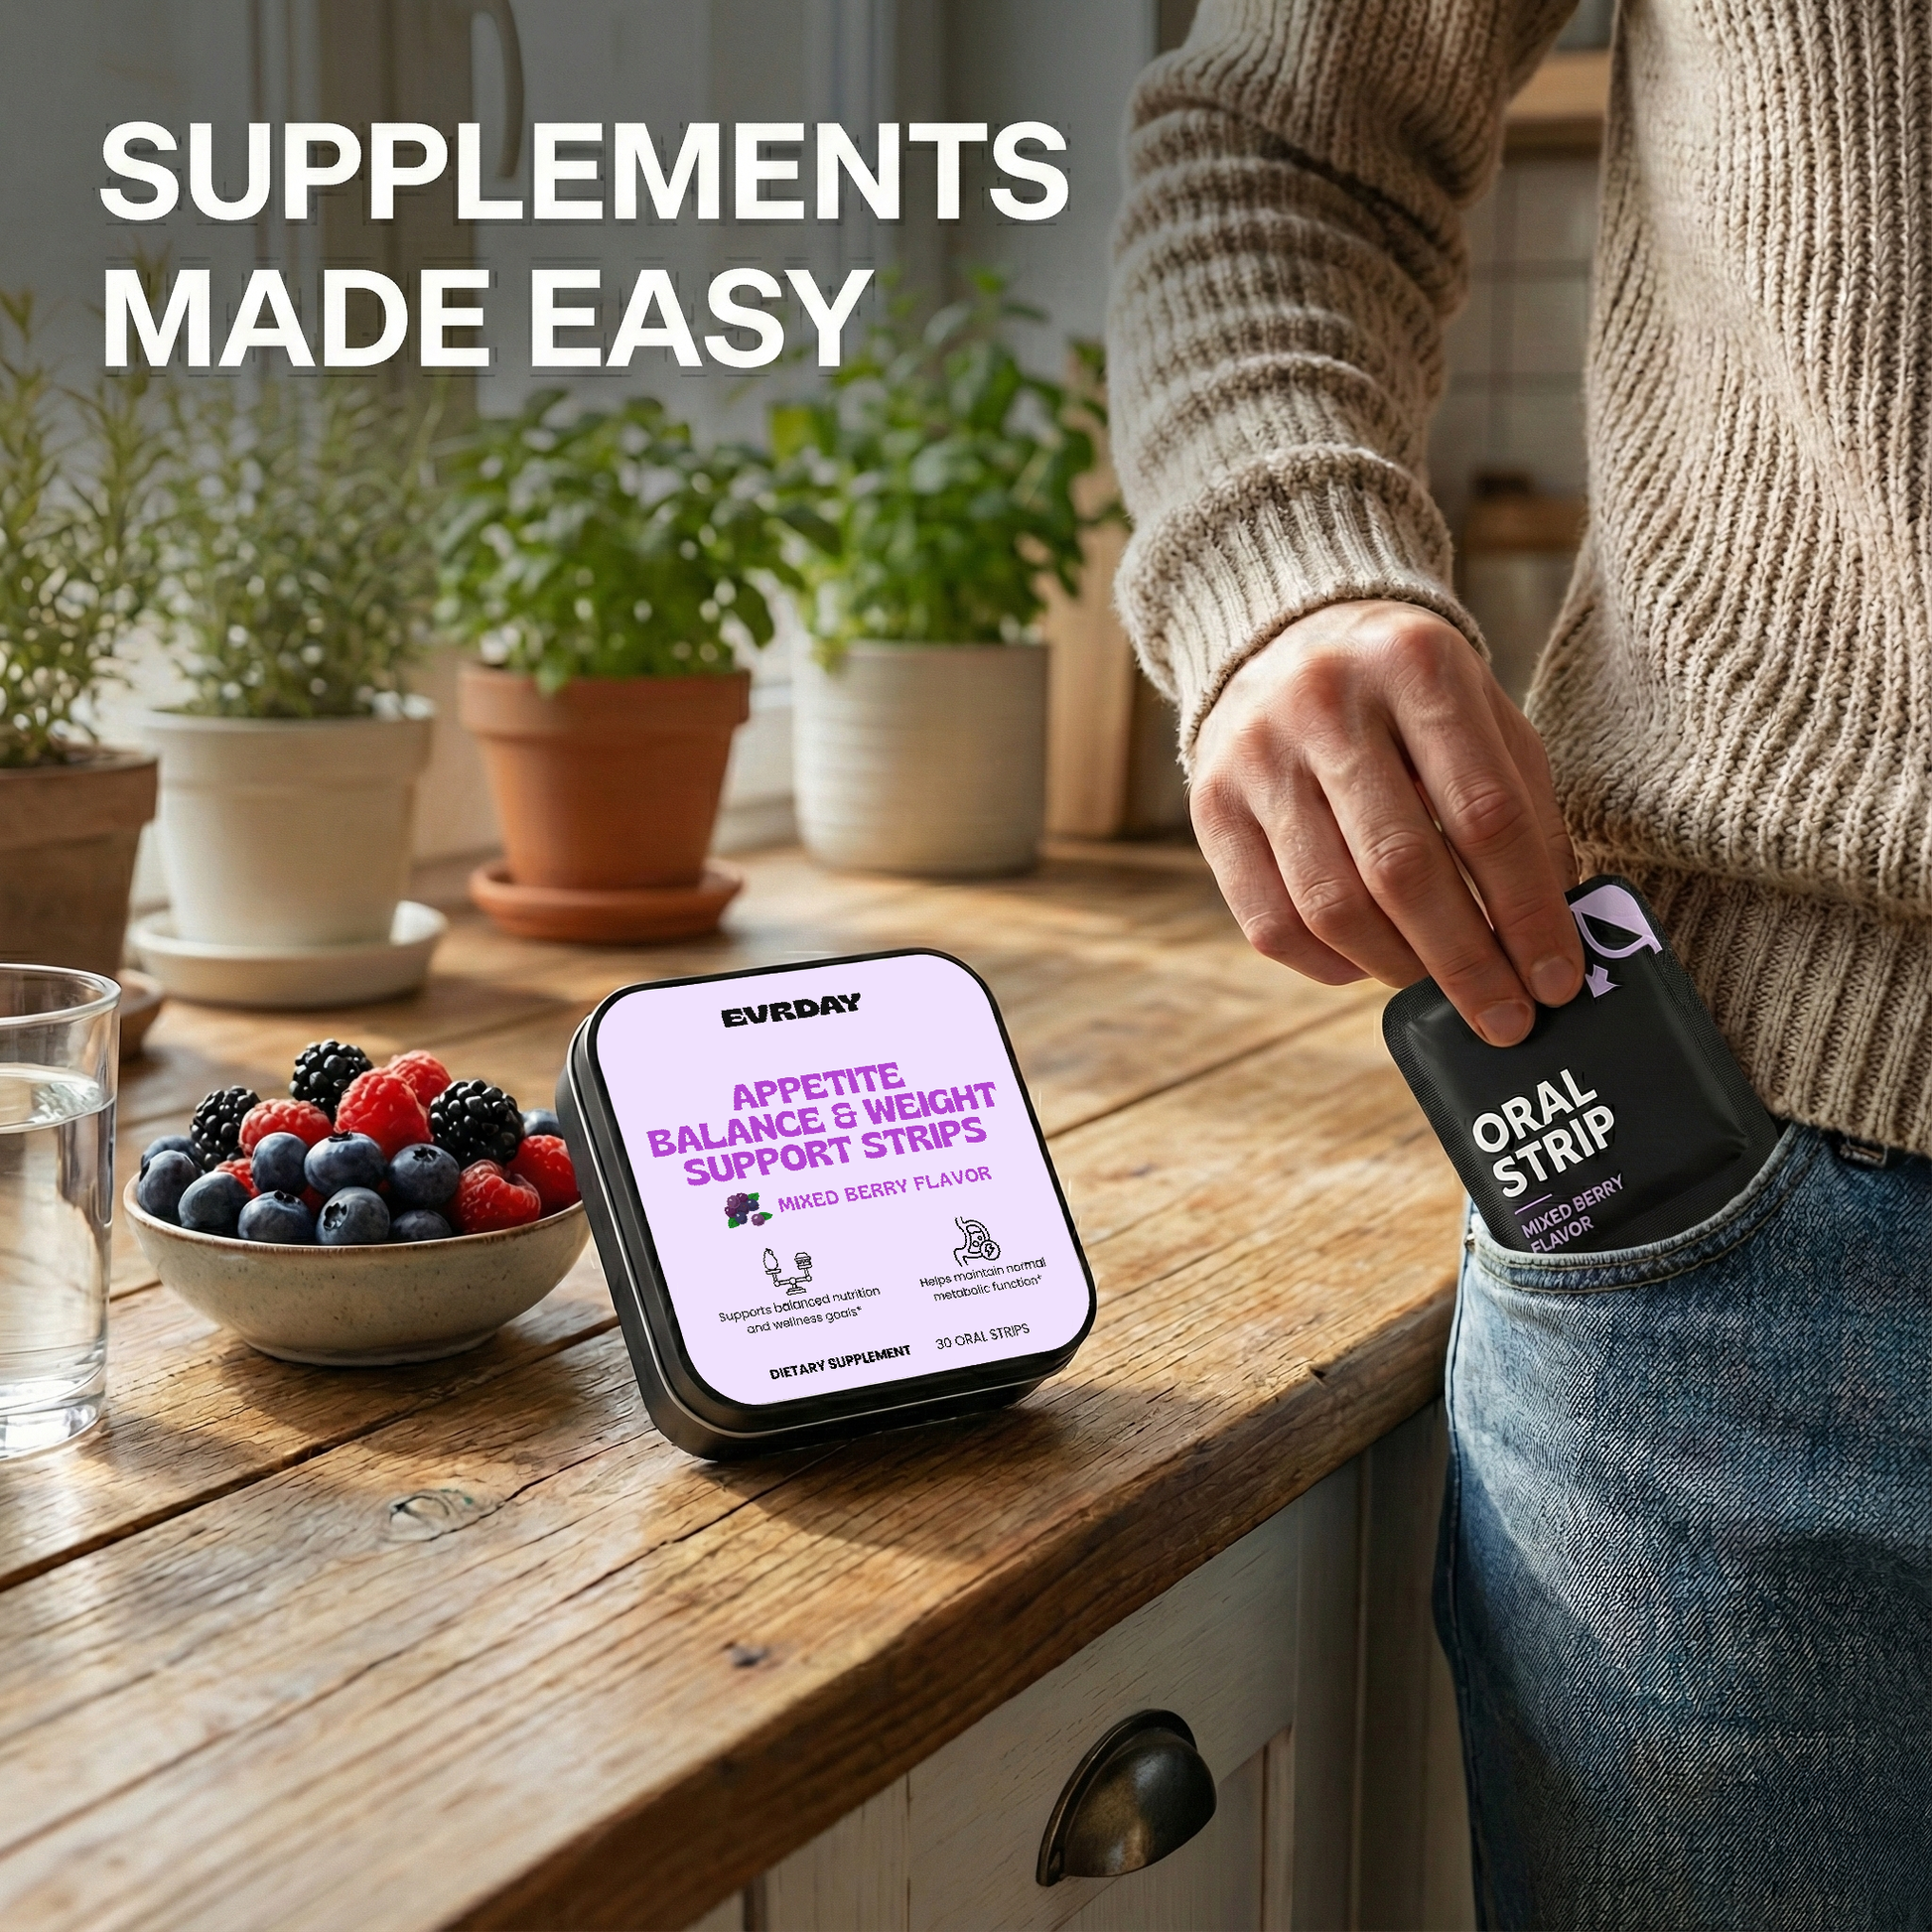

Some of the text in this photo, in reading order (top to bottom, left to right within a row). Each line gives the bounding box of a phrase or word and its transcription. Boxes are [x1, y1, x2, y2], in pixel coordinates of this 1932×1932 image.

[721, 992, 861, 1028] EVRDAY
[733, 1061, 905, 1111] APPETITE
[646, 1081, 996, 1158] BALANCE & WEIGHT
[1472, 1068, 1597, 1154] ORAL
[683, 1117, 987, 1185] SUPPORT STRIPS
[1492, 1105, 1614, 1198] STRIP
[778, 1166, 992, 1212] MIXED BERRY FLAVOR
[1521, 1173, 1623, 1239] MIXED BERRY
[1530, 1215, 1594, 1253] FLAVOR
[919, 1257, 1046, 1288] Helps maintain normal
[719, 1287, 881, 1323] Supports balanced nutrition
[933, 1284, 991, 1302] metabolic
[747, 1321, 771, 1333] and
[773, 1312, 824, 1329] wellness
[935, 1322, 1031, 1350] 30 ORAL STRIPS
[769, 1345, 910, 1380] DIETARY SUPPLEMENT
